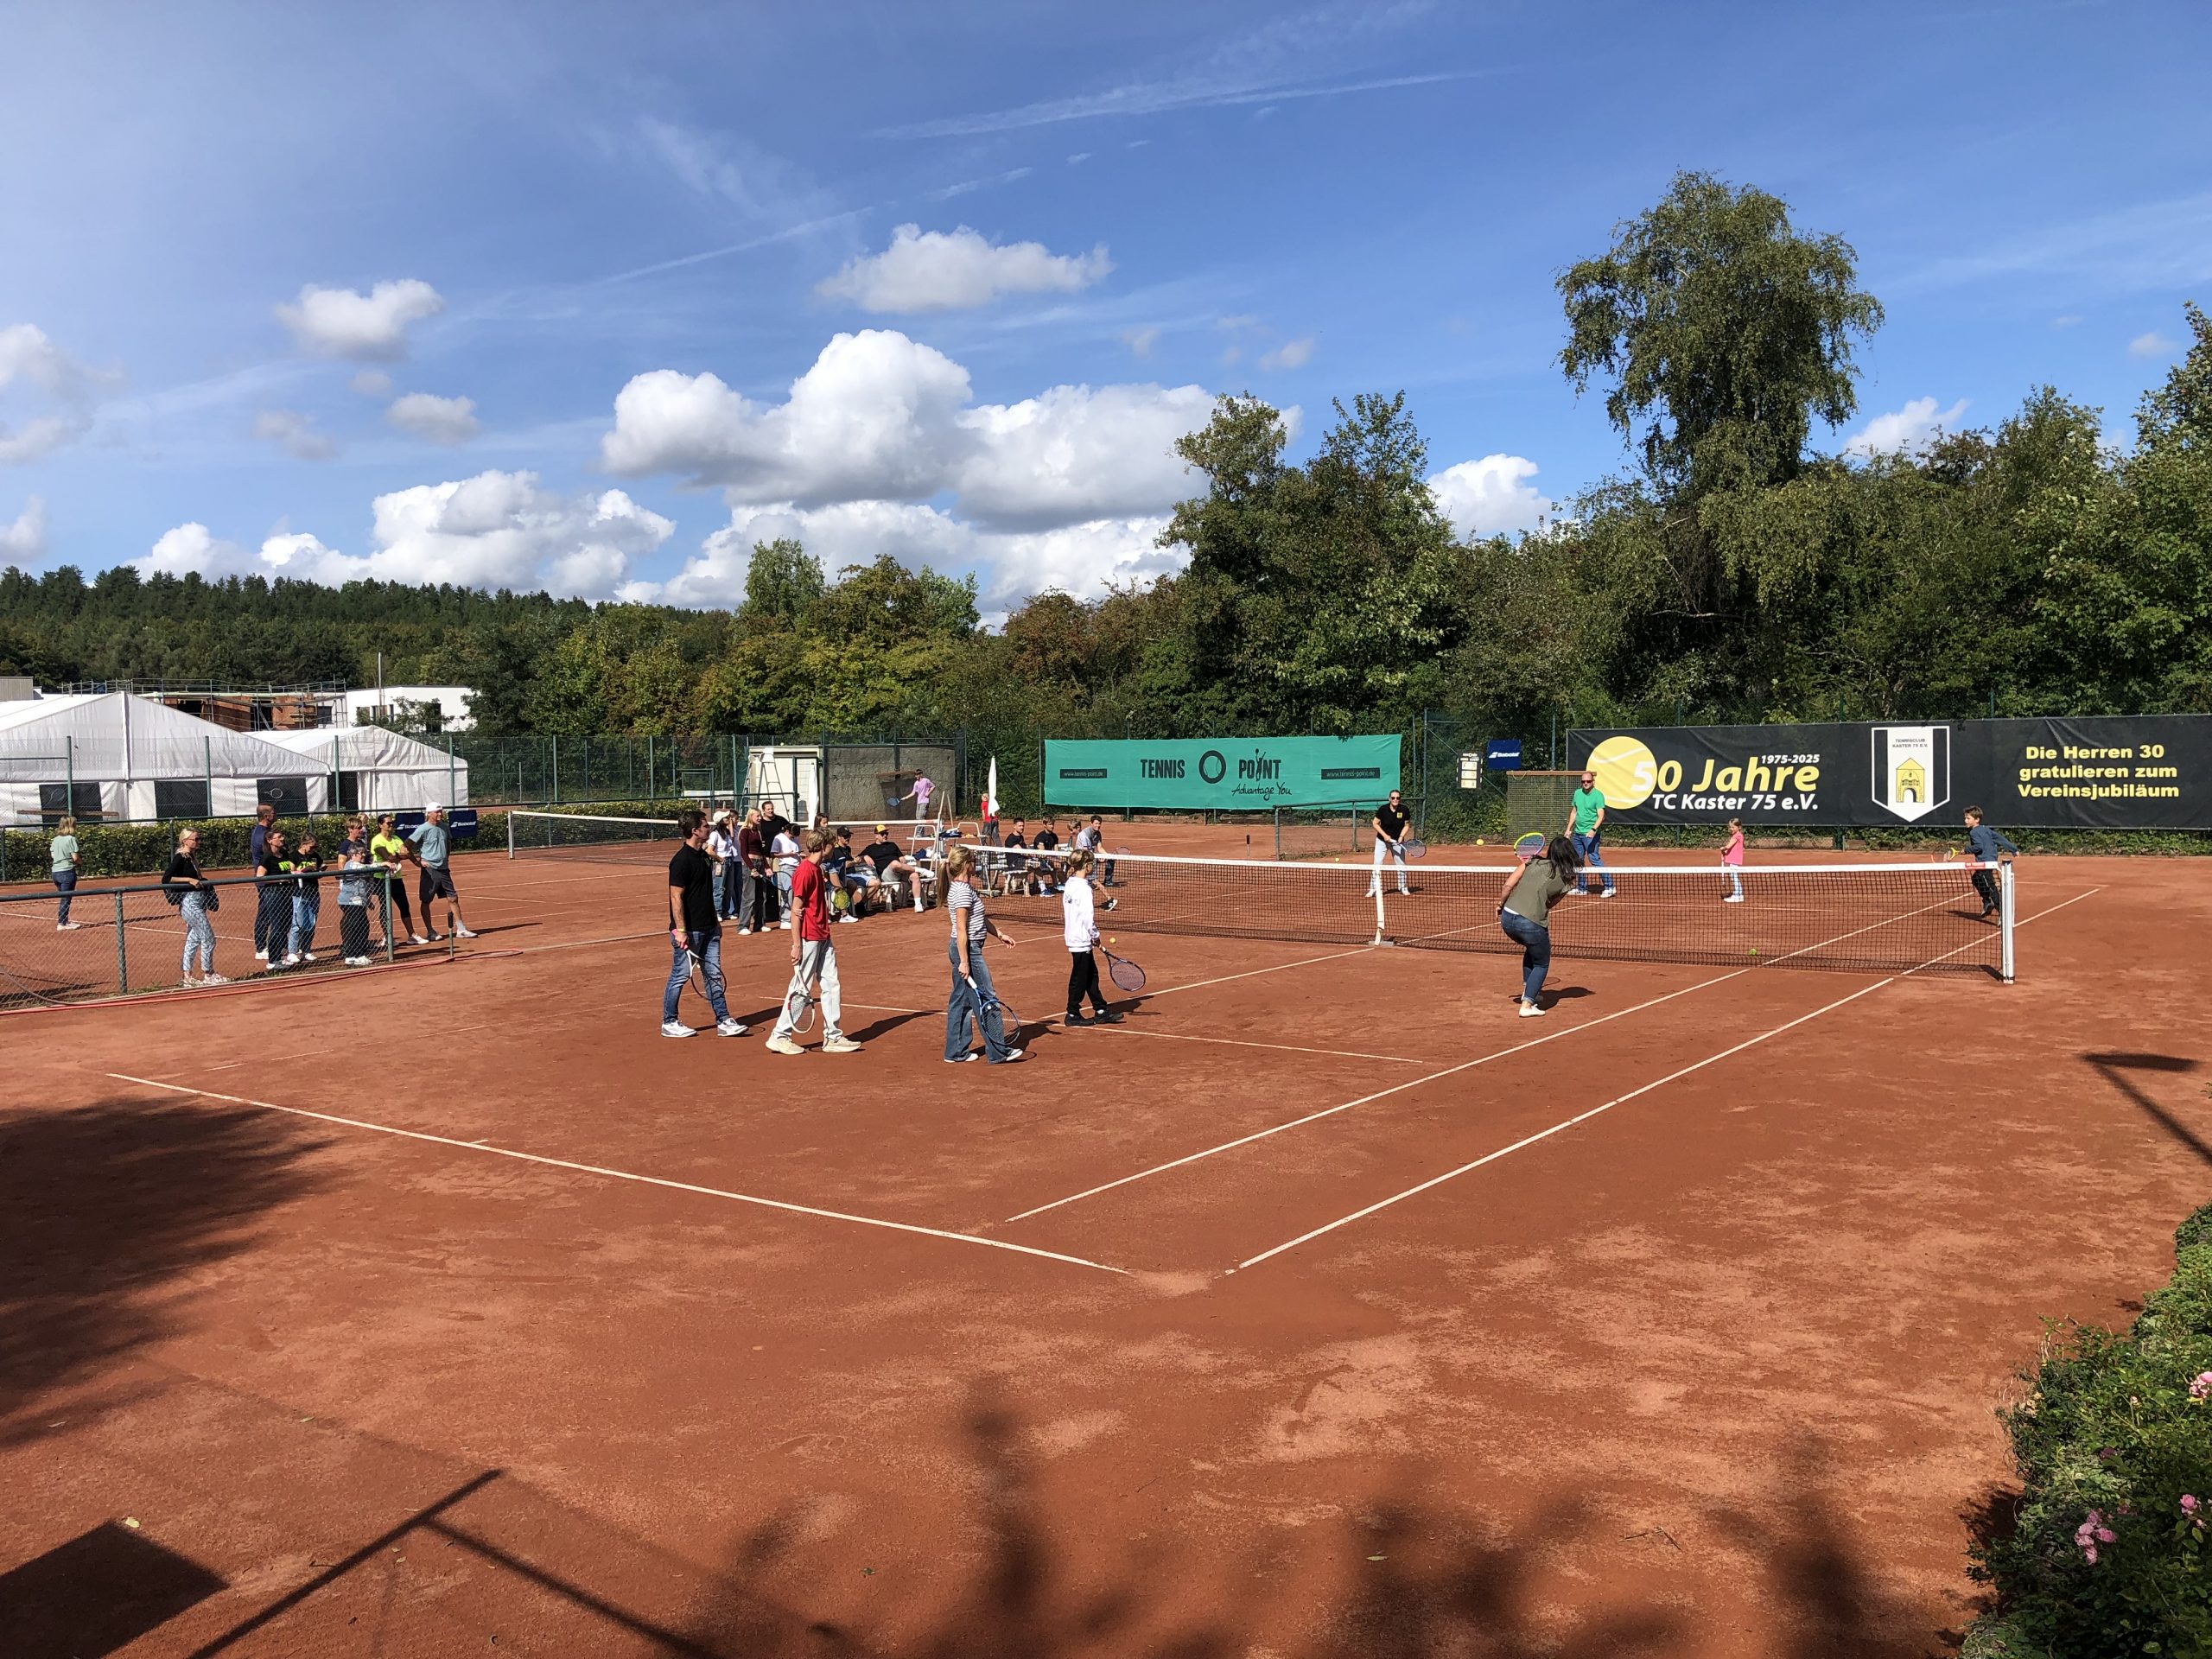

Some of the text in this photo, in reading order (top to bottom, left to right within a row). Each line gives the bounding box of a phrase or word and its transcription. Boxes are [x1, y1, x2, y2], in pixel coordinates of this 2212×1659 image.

[1761, 754, 1820, 764] 1975-2025
[2026, 745, 2164, 760] Die Herren 30
[1141, 760, 1185, 779] TENNIS
[1631, 757, 1820, 792] 50 Jahre
[2019, 766, 2177, 781] gratulieren zum
[1231, 782, 1292, 801] Advantage You
[2018, 785, 2179, 800] Vereinsjubiläum
[1653, 794, 1819, 810] TC Kaster 75 e.V.
